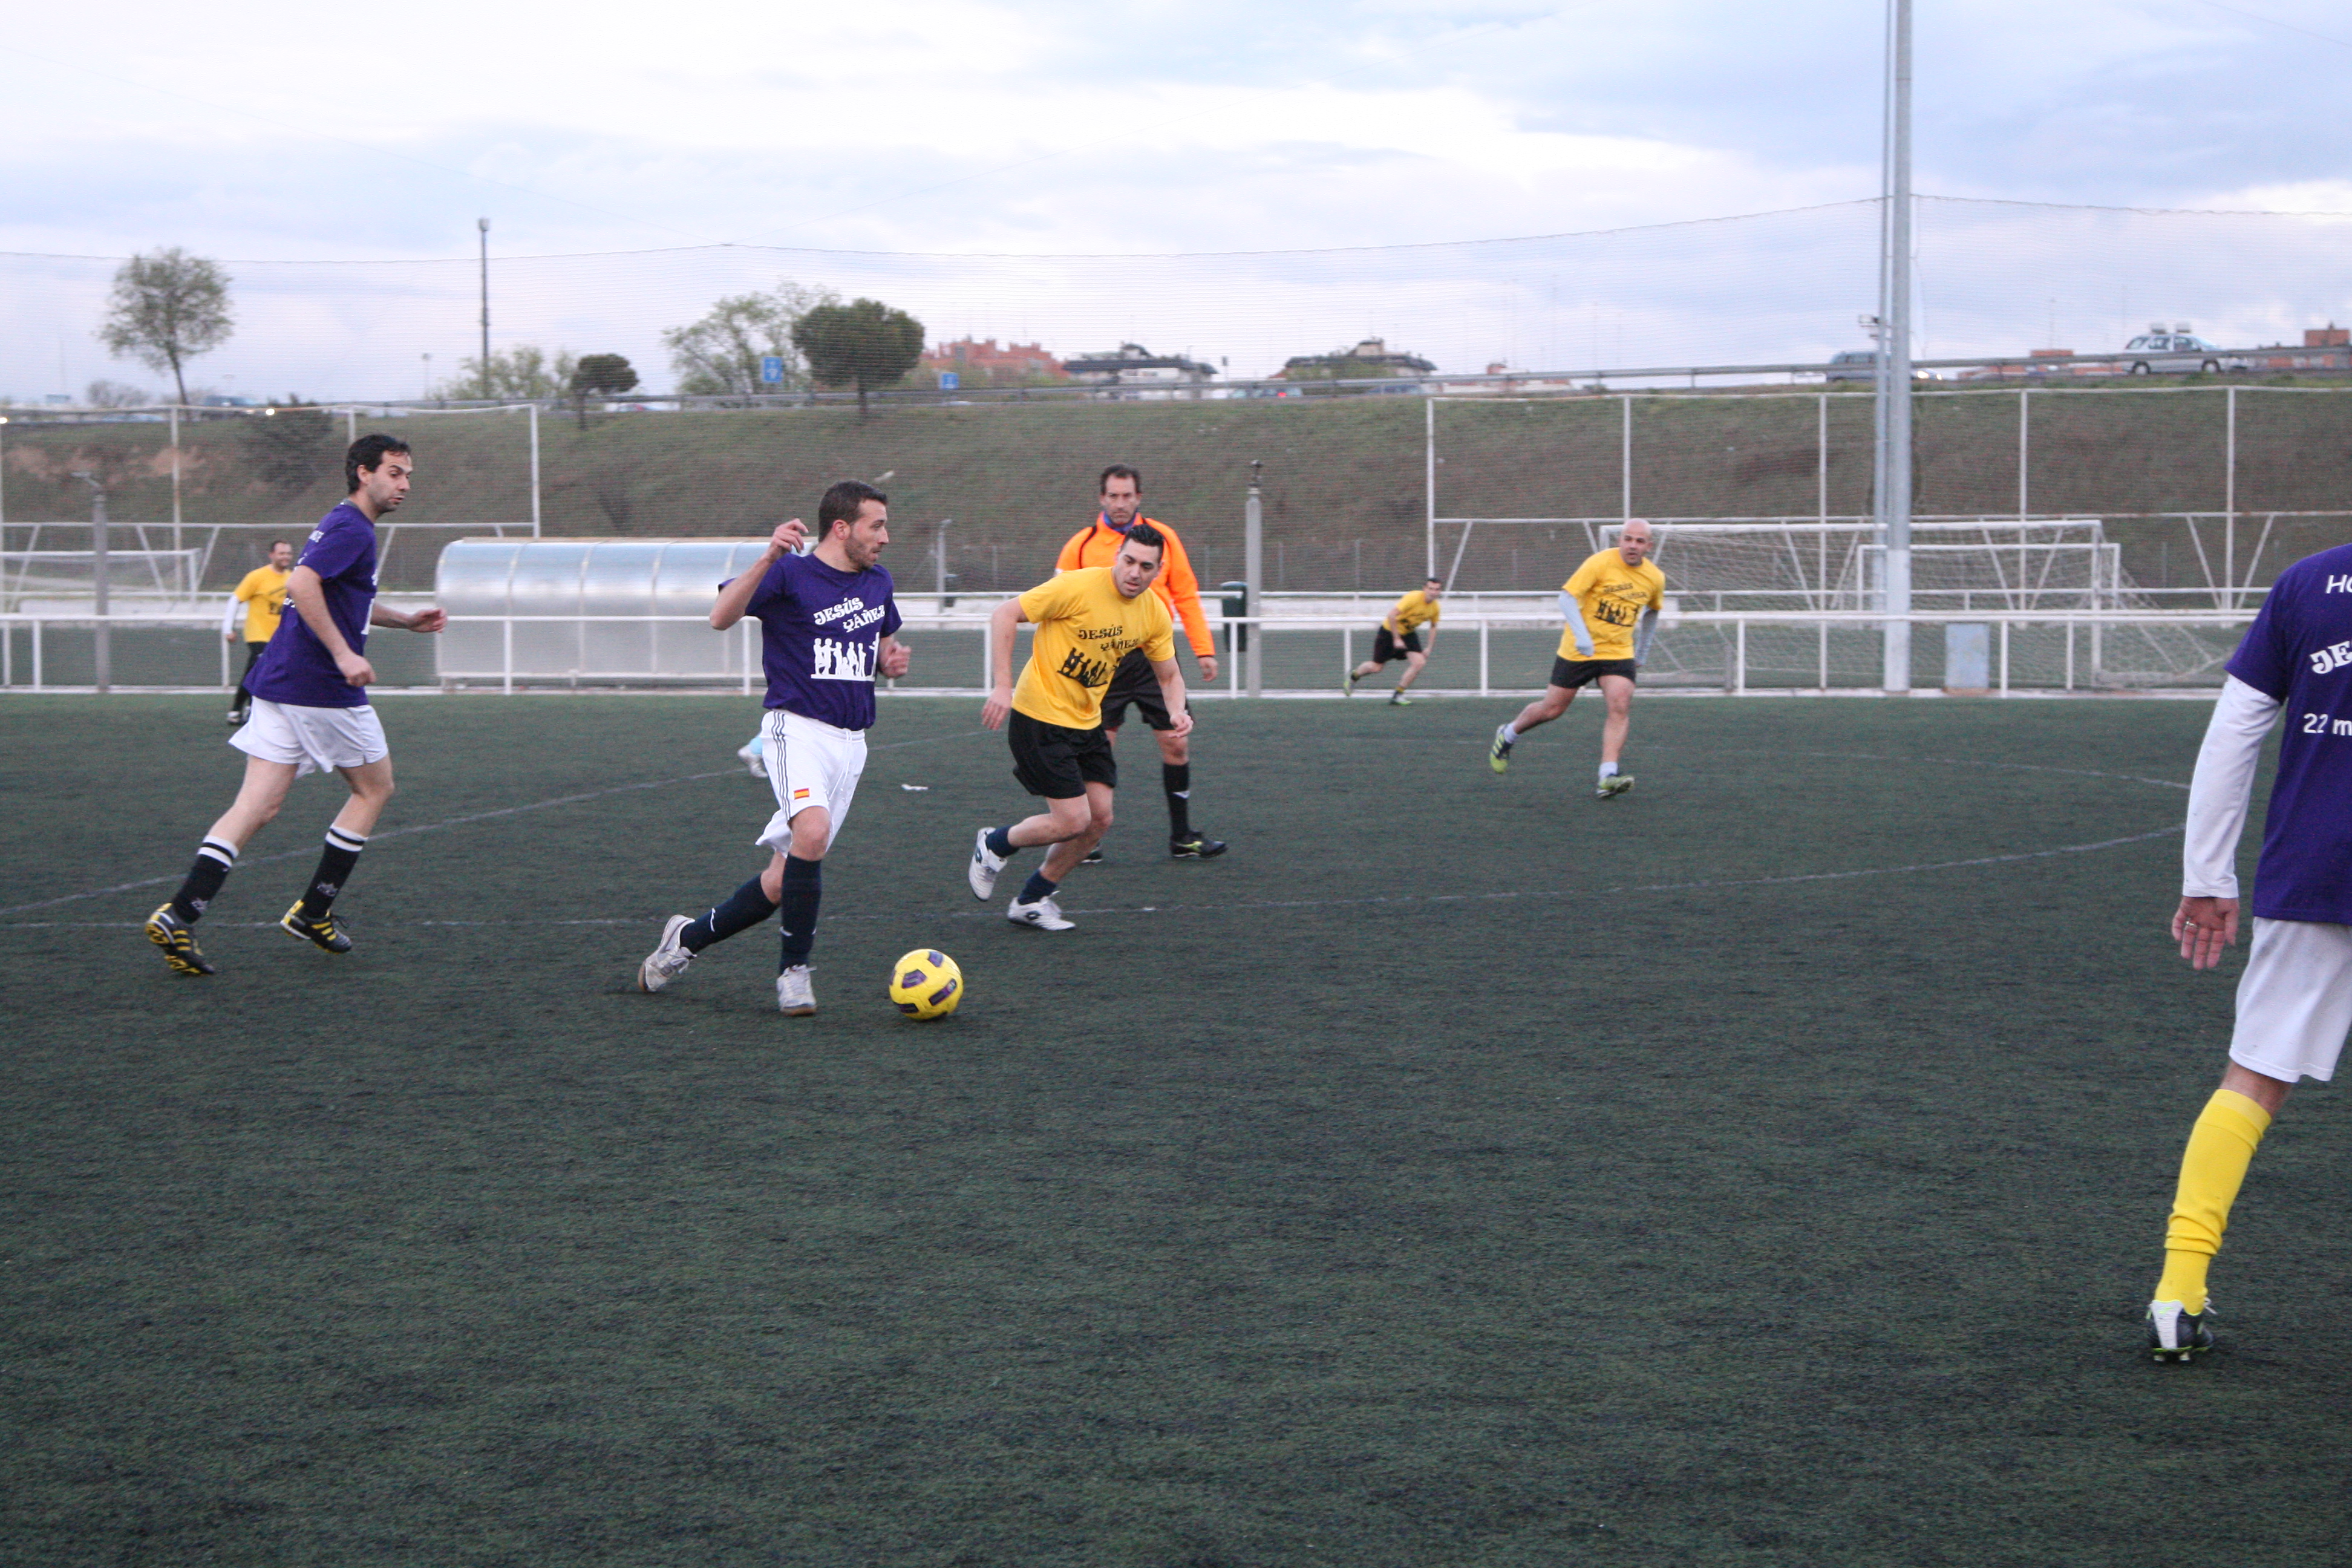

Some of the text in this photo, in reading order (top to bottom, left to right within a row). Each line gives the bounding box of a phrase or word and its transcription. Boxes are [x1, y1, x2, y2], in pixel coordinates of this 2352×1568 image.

[813, 597, 864, 626] JESÚS
[1078, 624, 1123, 639] JESÚS
[2304, 713, 2328, 733] 22
